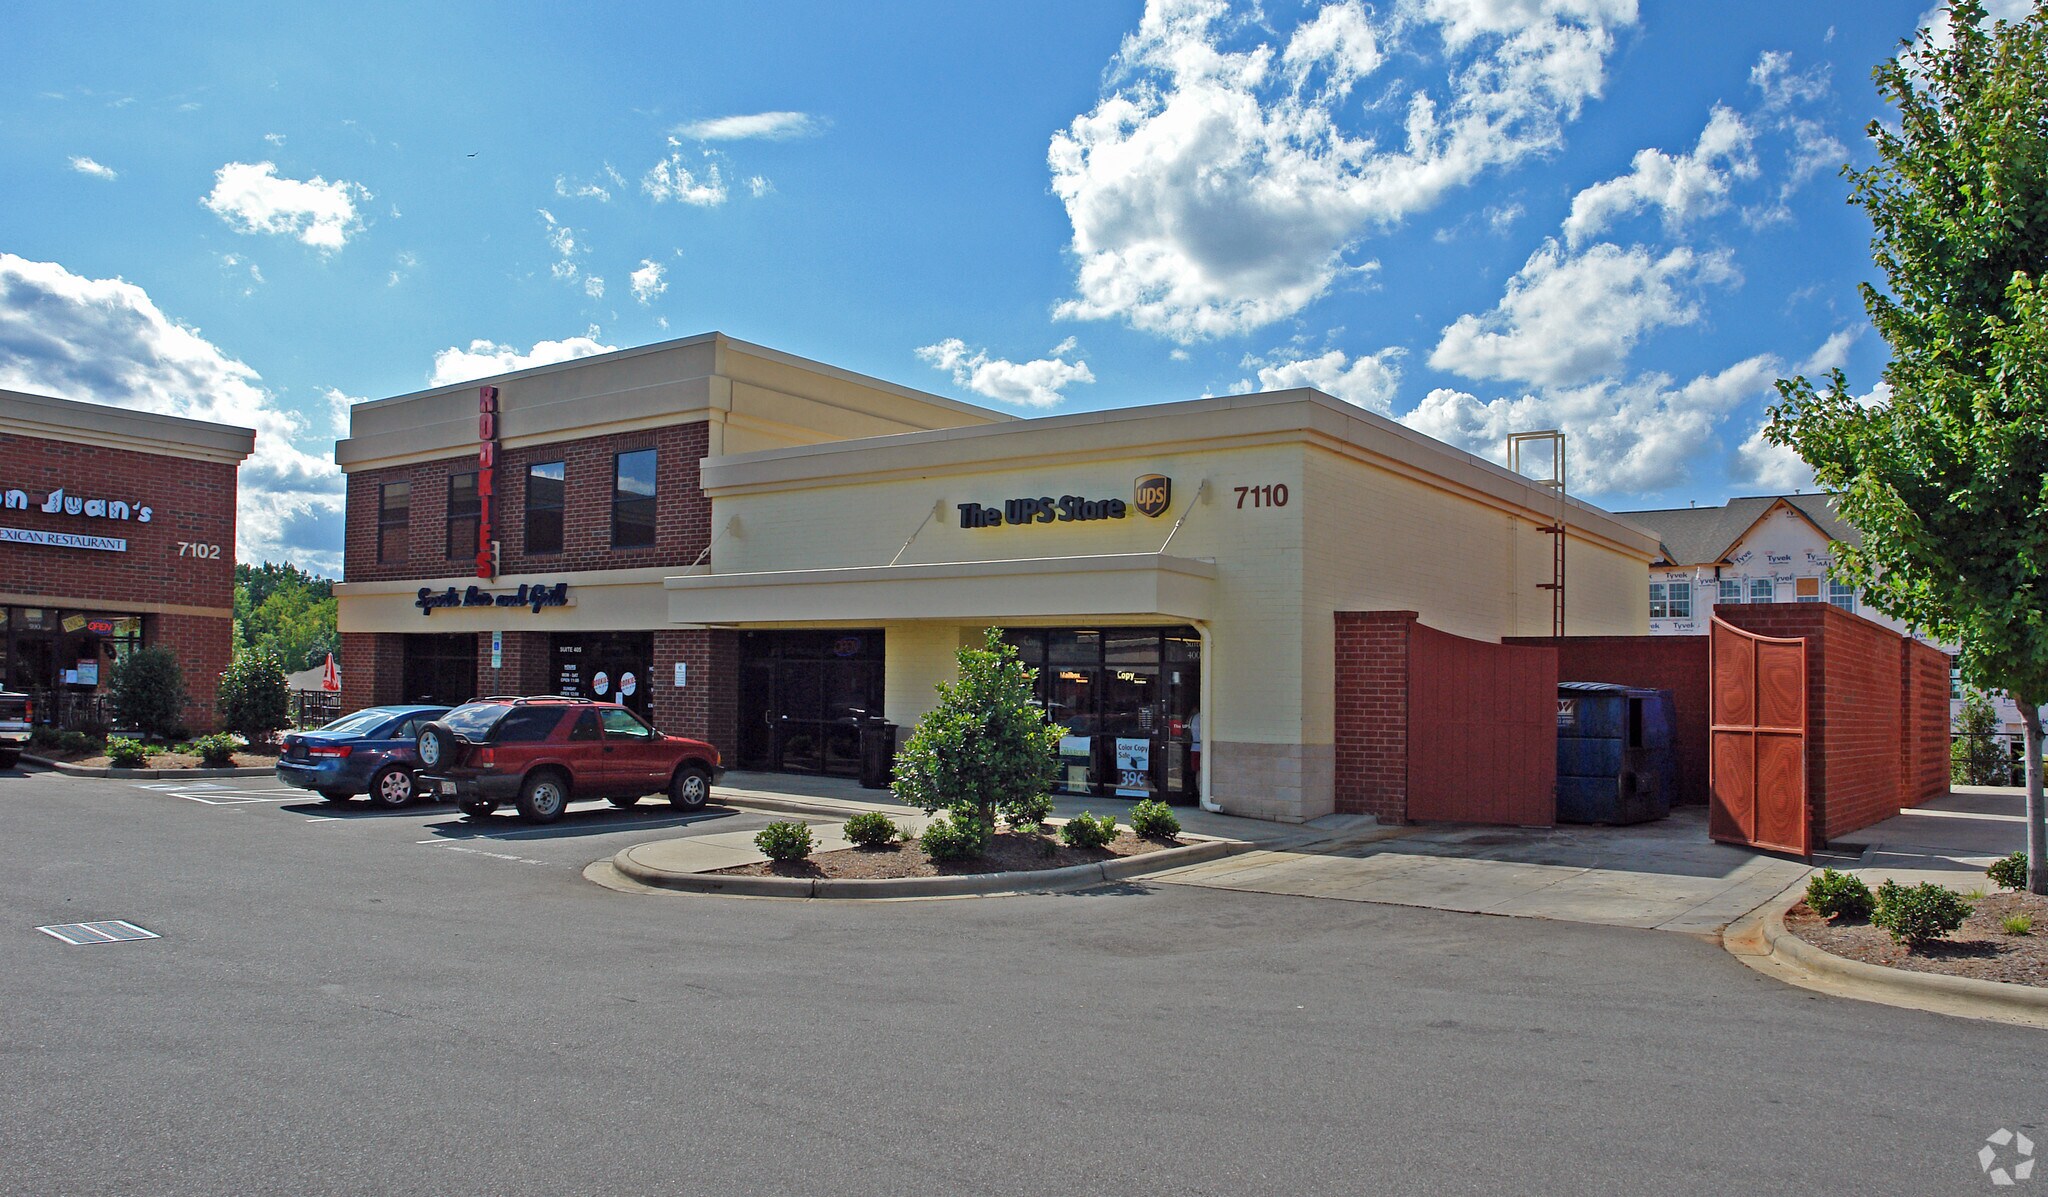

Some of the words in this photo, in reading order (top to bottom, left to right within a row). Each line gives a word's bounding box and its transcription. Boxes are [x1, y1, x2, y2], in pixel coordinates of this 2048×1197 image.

[1234, 484, 1289, 509] 7110
[0, 489, 28, 510] n
[41, 488, 153, 523] Juan's
[958, 503, 1002, 528] The
[1005, 497, 1055, 524] UPS
[1058, 495, 1126, 521] Store
[1137, 487, 1164, 510] ups
[47, 533, 123, 550] RESTAURANT
[177, 541, 220, 560] 7102
[1767, 554, 1791, 563] Tyvek
[87, 621, 113, 631] OPEN
[1117, 670, 1135, 681] Copy
[1118, 743, 1133, 751] Color
[1134, 744, 1148, 753] Copy
[1120, 771, 1144, 787] 39¢
